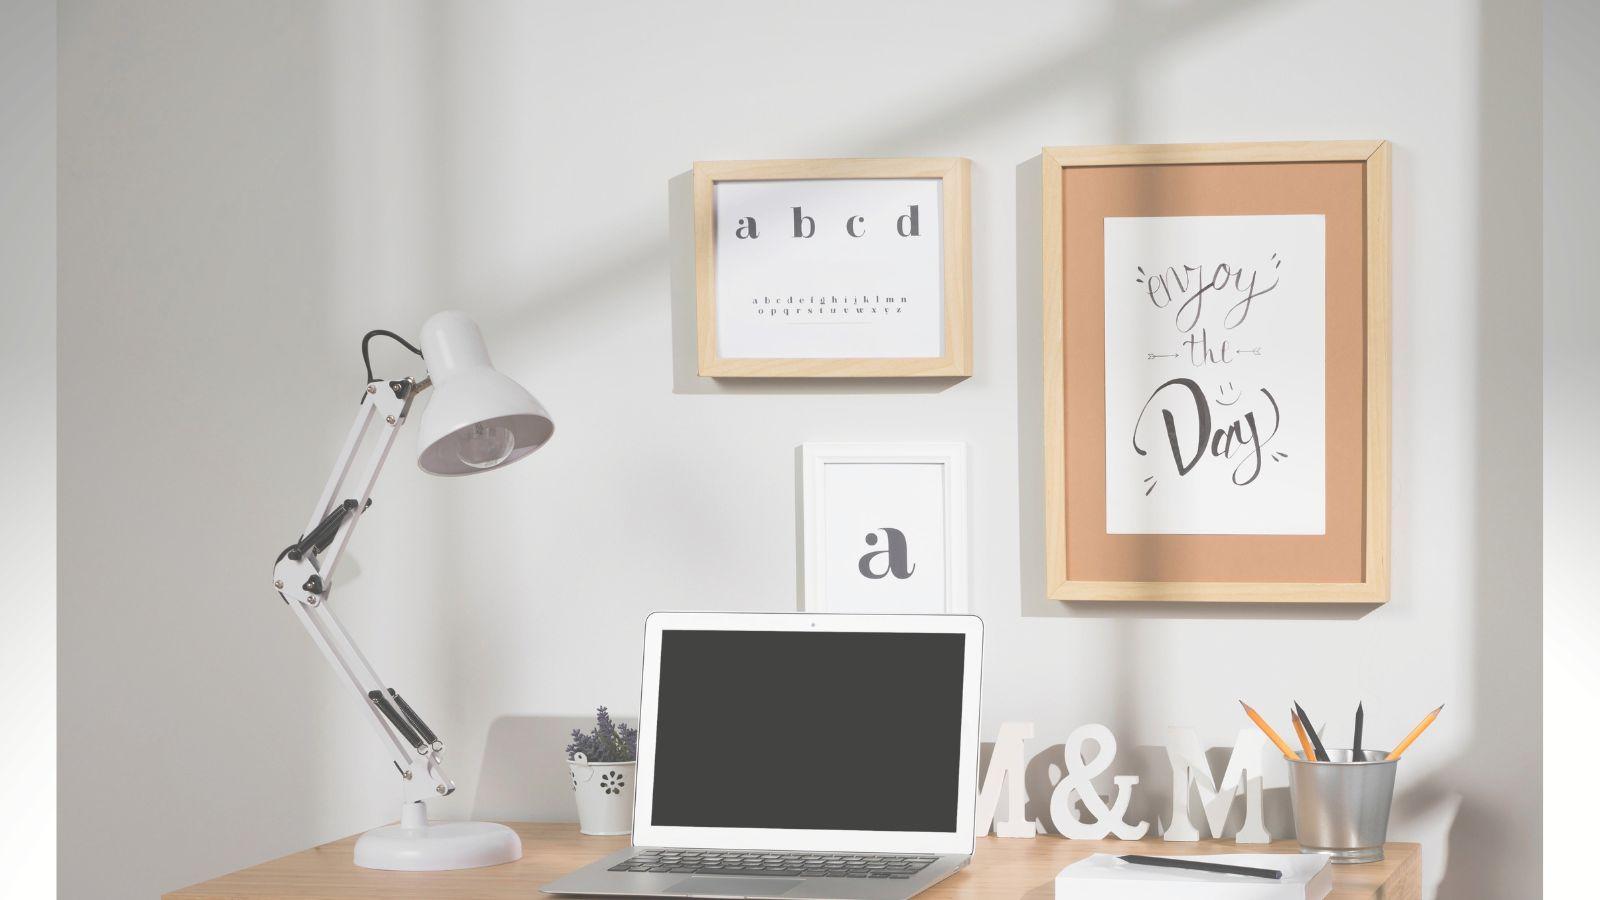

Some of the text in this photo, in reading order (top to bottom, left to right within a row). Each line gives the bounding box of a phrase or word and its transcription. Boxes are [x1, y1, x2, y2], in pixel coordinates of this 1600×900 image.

[735, 204, 921, 240] a b c d
[1147, 263, 1280, 333] enjoy
[1182, 328, 1233, 367] the
[1132, 377, 1280, 487] Day
[858, 527, 916, 580] a
[1050, 723, 1150, 840] &
[1163, 725, 1272, 844] M
